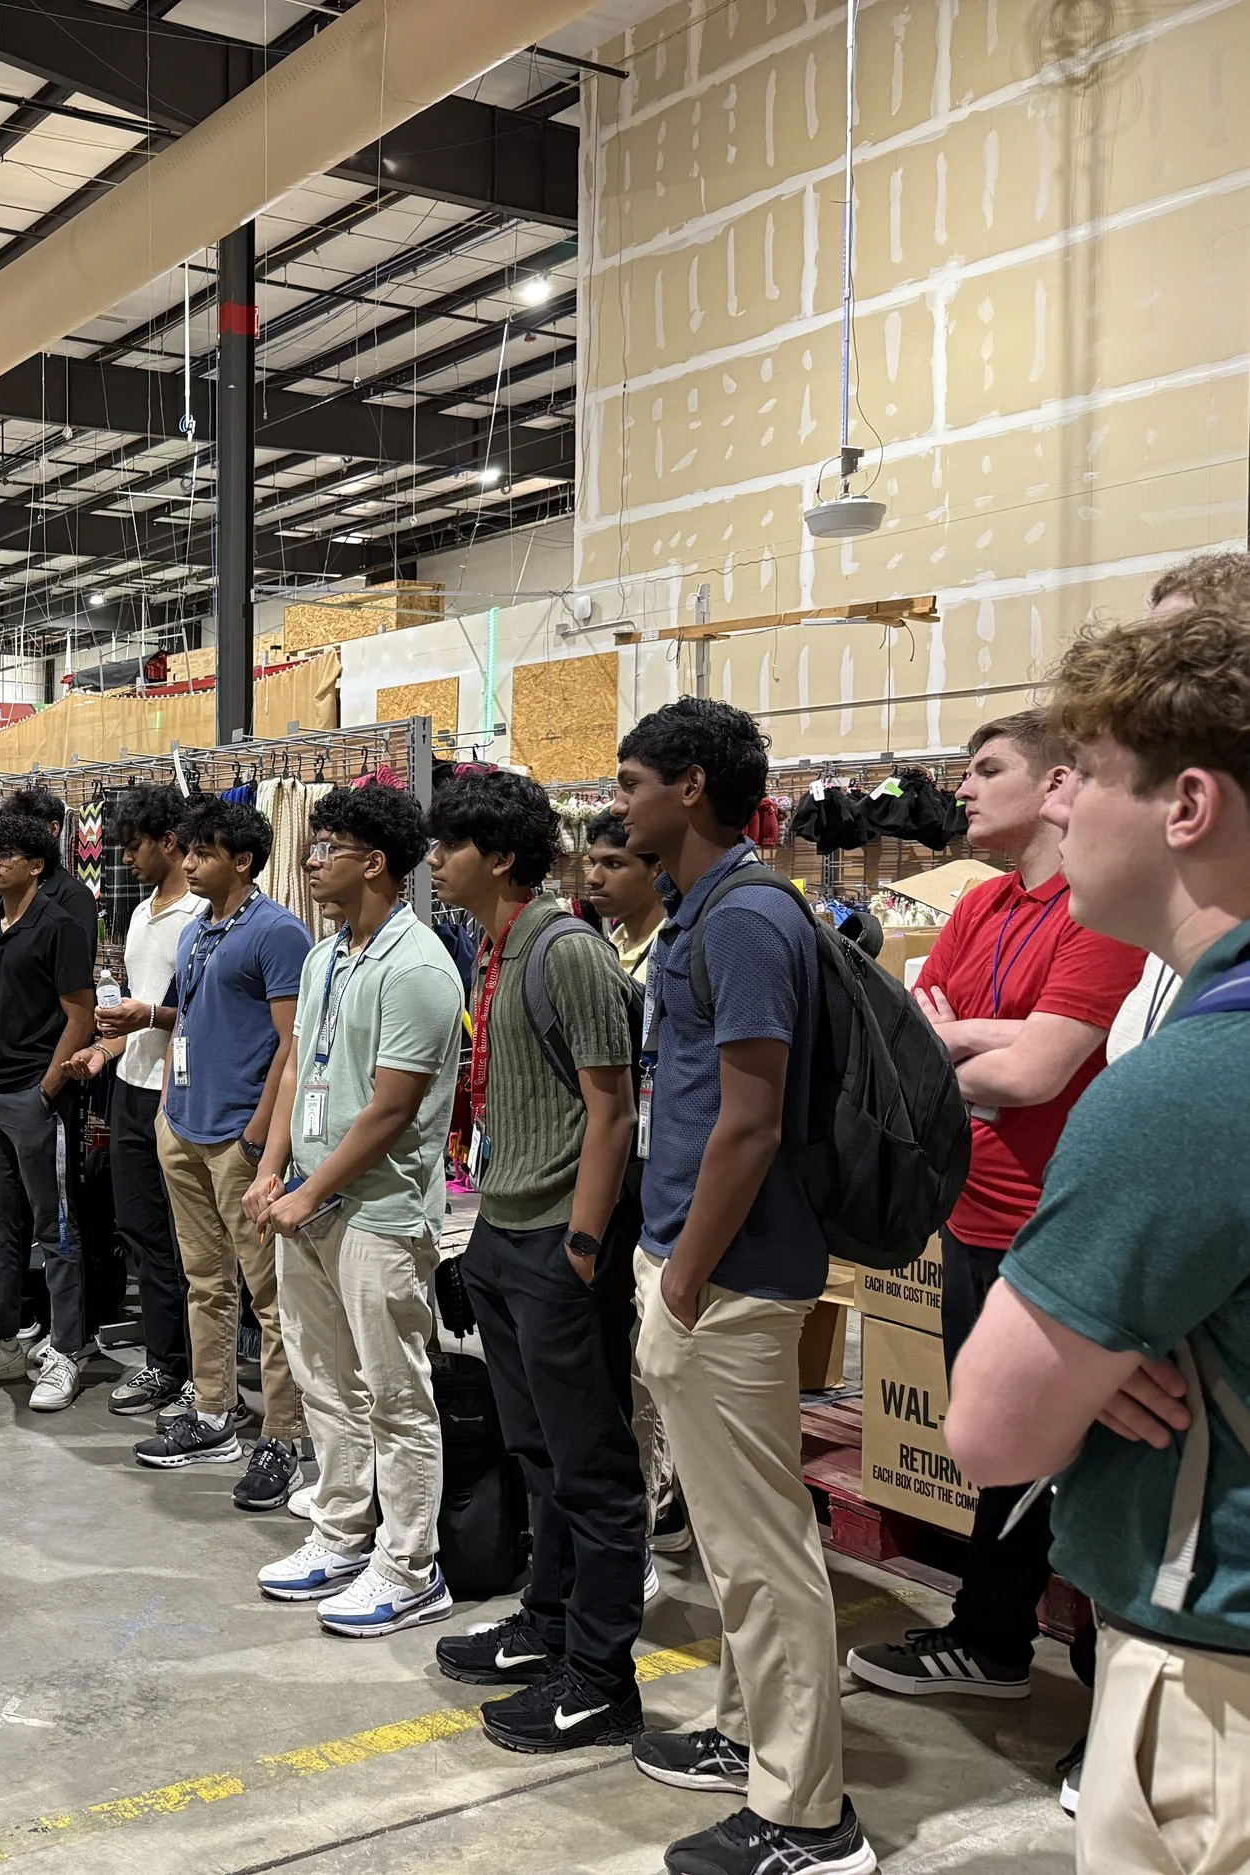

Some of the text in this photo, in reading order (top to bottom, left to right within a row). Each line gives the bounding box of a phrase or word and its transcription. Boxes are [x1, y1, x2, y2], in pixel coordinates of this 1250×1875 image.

[864, 1274, 941, 1309] EACH BOX COST THE
[873, 1464, 894, 1485] EACH
[895, 1472, 912, 1491] BOX
[913, 1478, 936, 1499] COST
[936, 1485, 954, 1505] THE
[899, 1443, 962, 1487] RETURN
